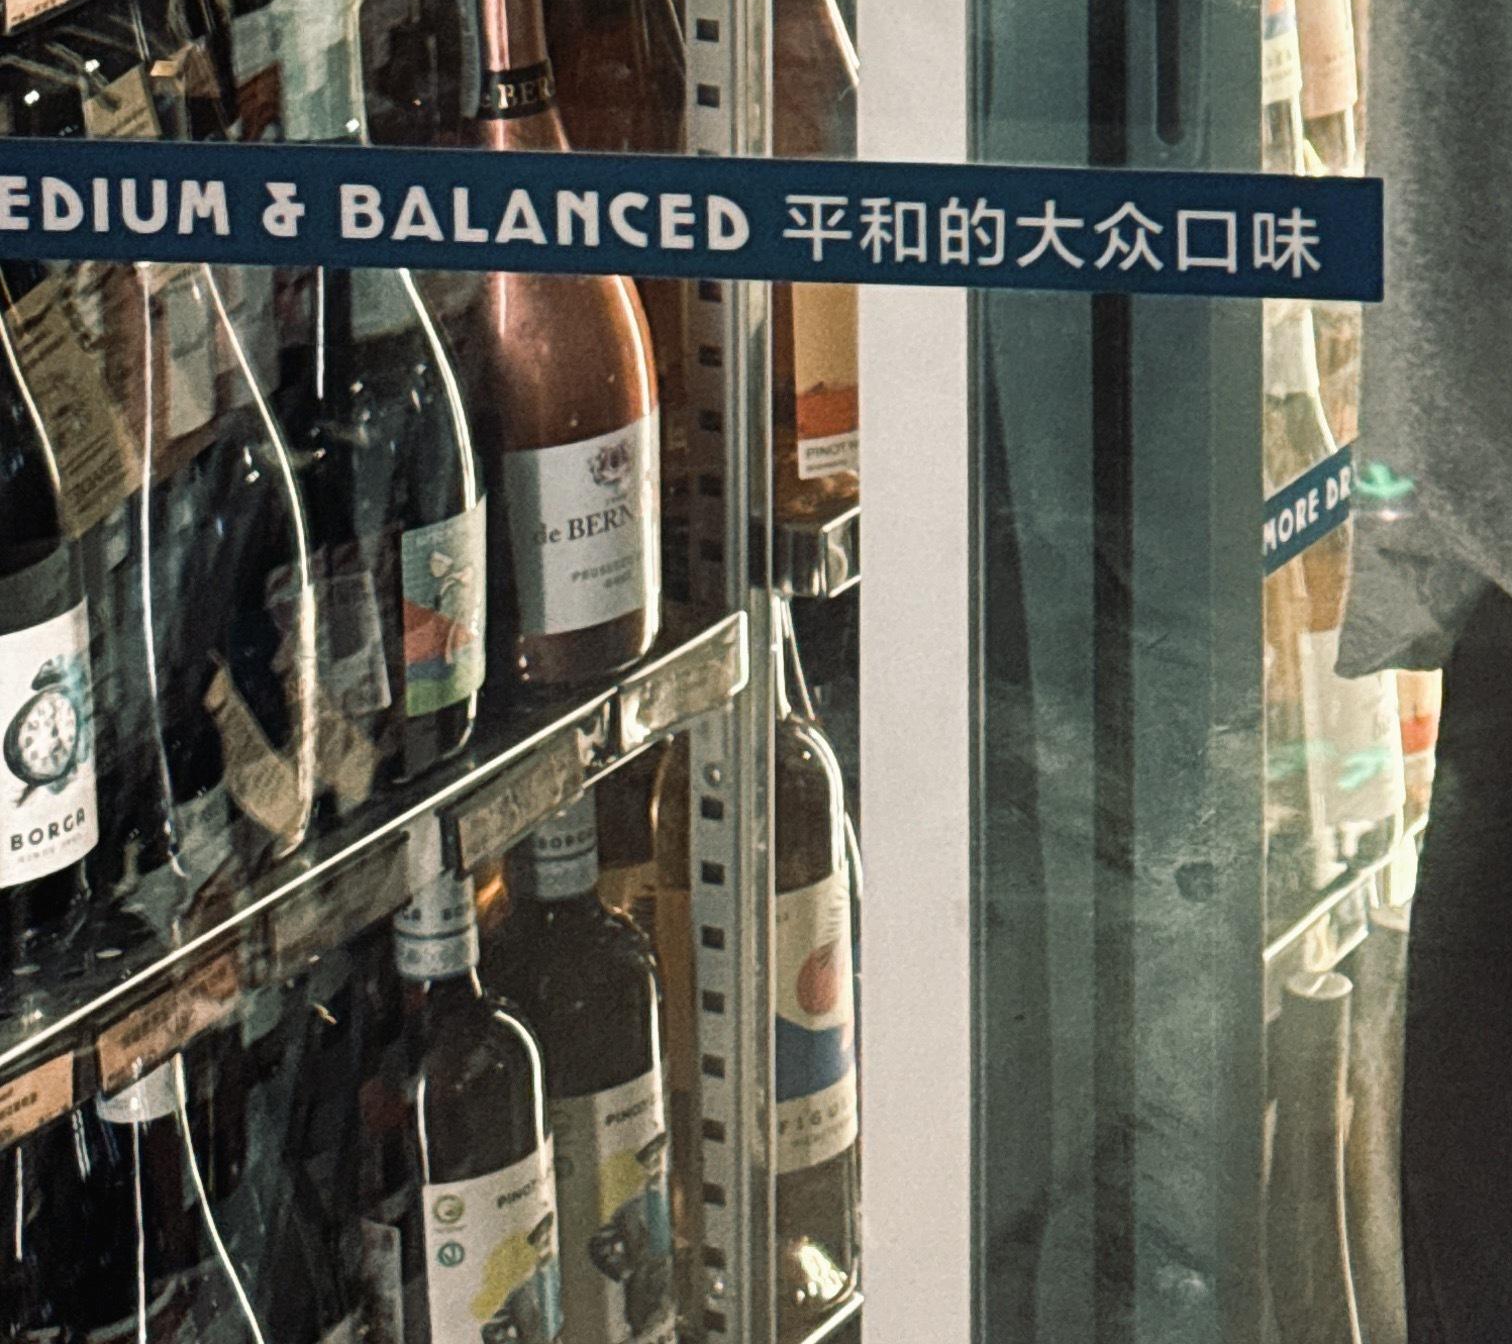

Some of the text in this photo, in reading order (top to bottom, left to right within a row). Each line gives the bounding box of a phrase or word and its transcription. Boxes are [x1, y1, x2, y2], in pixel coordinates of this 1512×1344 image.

[261, 181, 306, 238] &
[339, 182, 750, 252] BALANCED
[782, 193, 1322, 279] 平和的大众口味
[1261, 465, 1353, 556] MORE DR
[9, 807, 86, 852] BORGA
